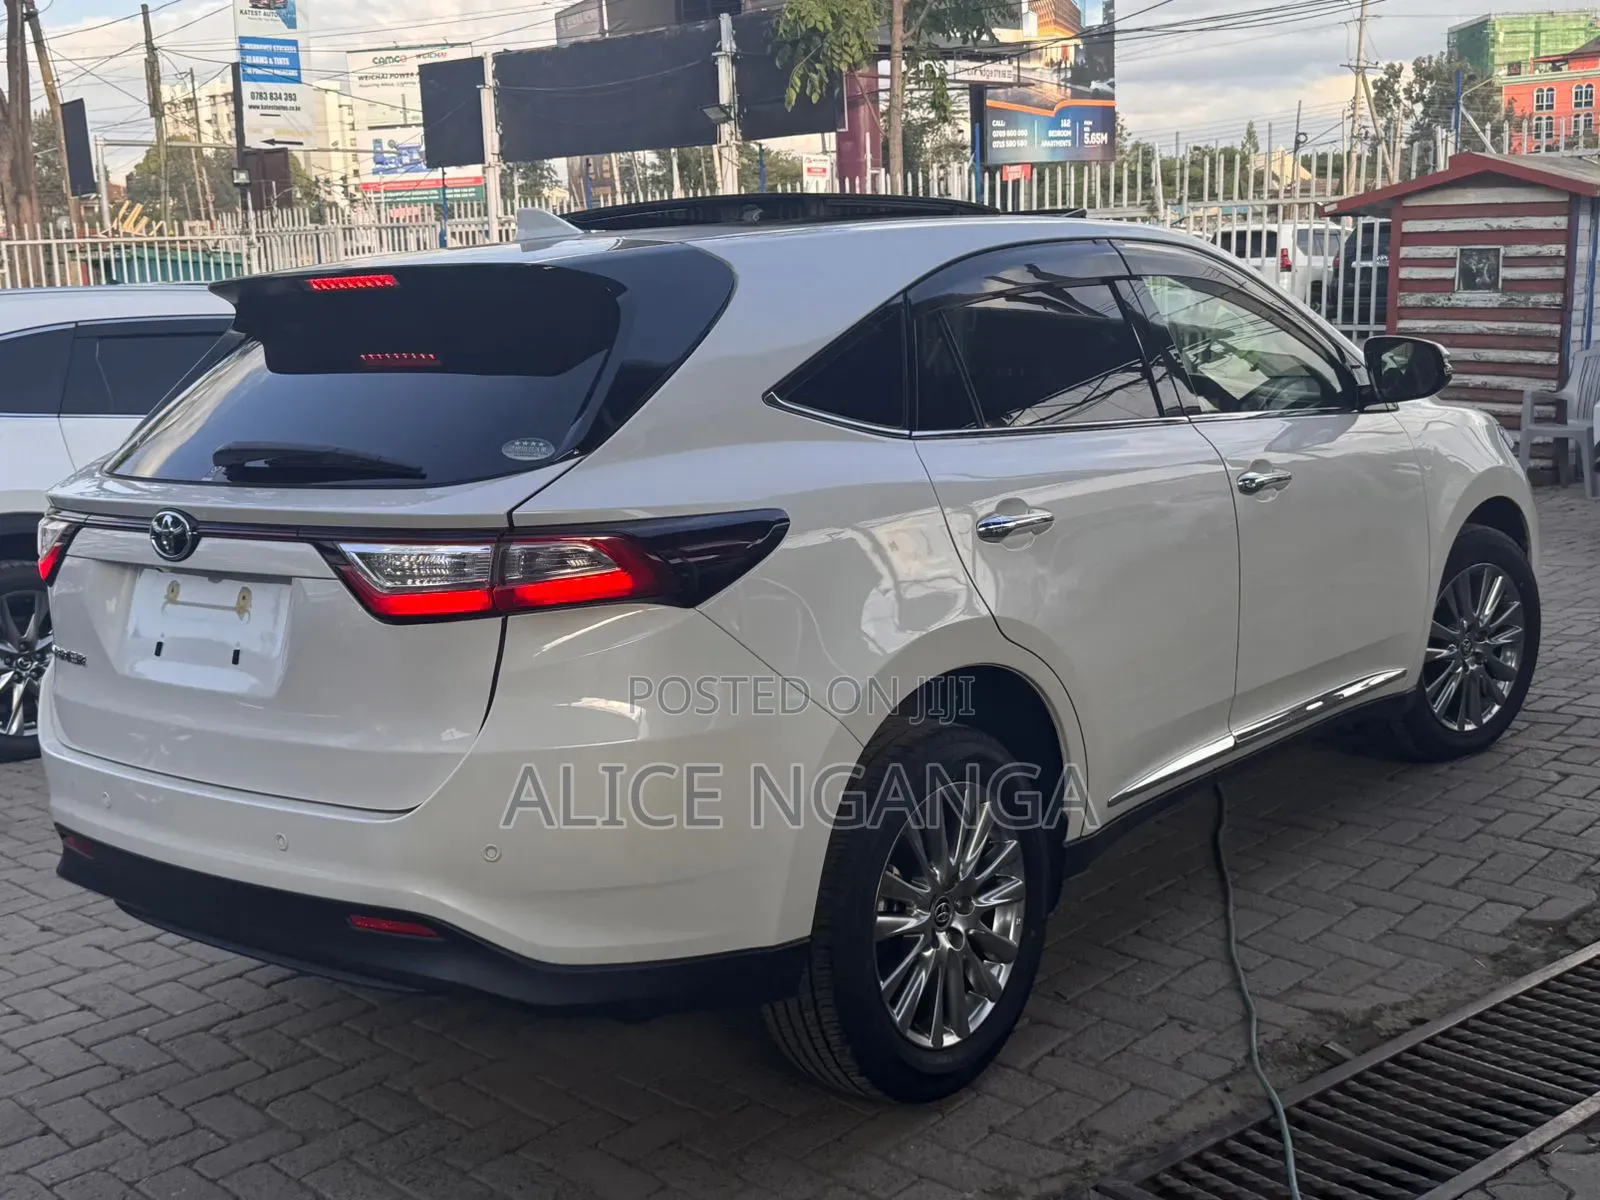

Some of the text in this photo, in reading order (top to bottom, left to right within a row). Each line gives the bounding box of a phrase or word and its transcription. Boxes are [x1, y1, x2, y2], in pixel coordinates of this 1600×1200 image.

[240, 9, 262, 17] KATEST
[372, 55, 407, 65] CAMCO
[389, 72, 414, 80] POWER
[269, 92, 283, 102] 834
[283, 92, 298, 102] 393
[1084, 133, 1108, 145] 5.65M
[1040, 140, 1072, 148] APARTMENTS
